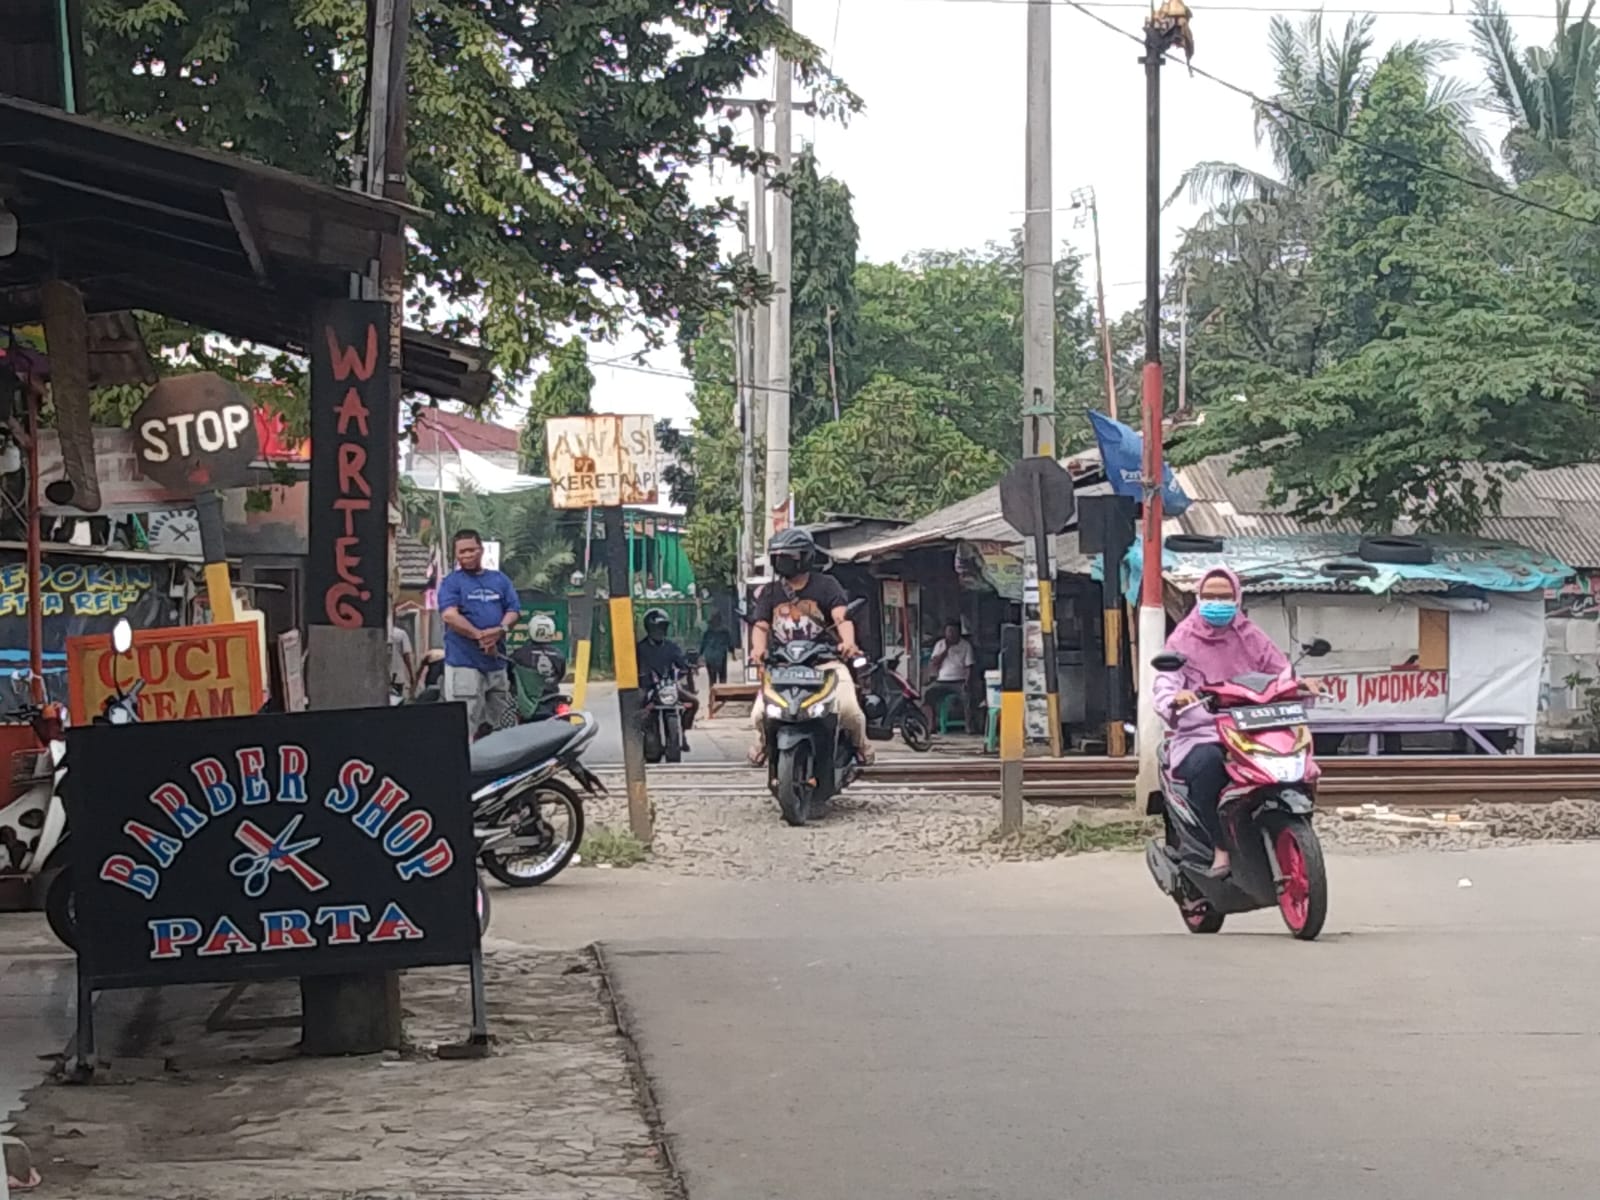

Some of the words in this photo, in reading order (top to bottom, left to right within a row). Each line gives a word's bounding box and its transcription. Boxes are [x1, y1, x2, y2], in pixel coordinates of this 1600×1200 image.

[140, 404, 250, 462] STOP
[326, 323, 378, 629] WARTEG
[98, 639, 231, 689] CUCI
[100, 745, 308, 900] BARBER
[325, 759, 454, 881] SHOP
[148, 903, 424, 959] PARTA
